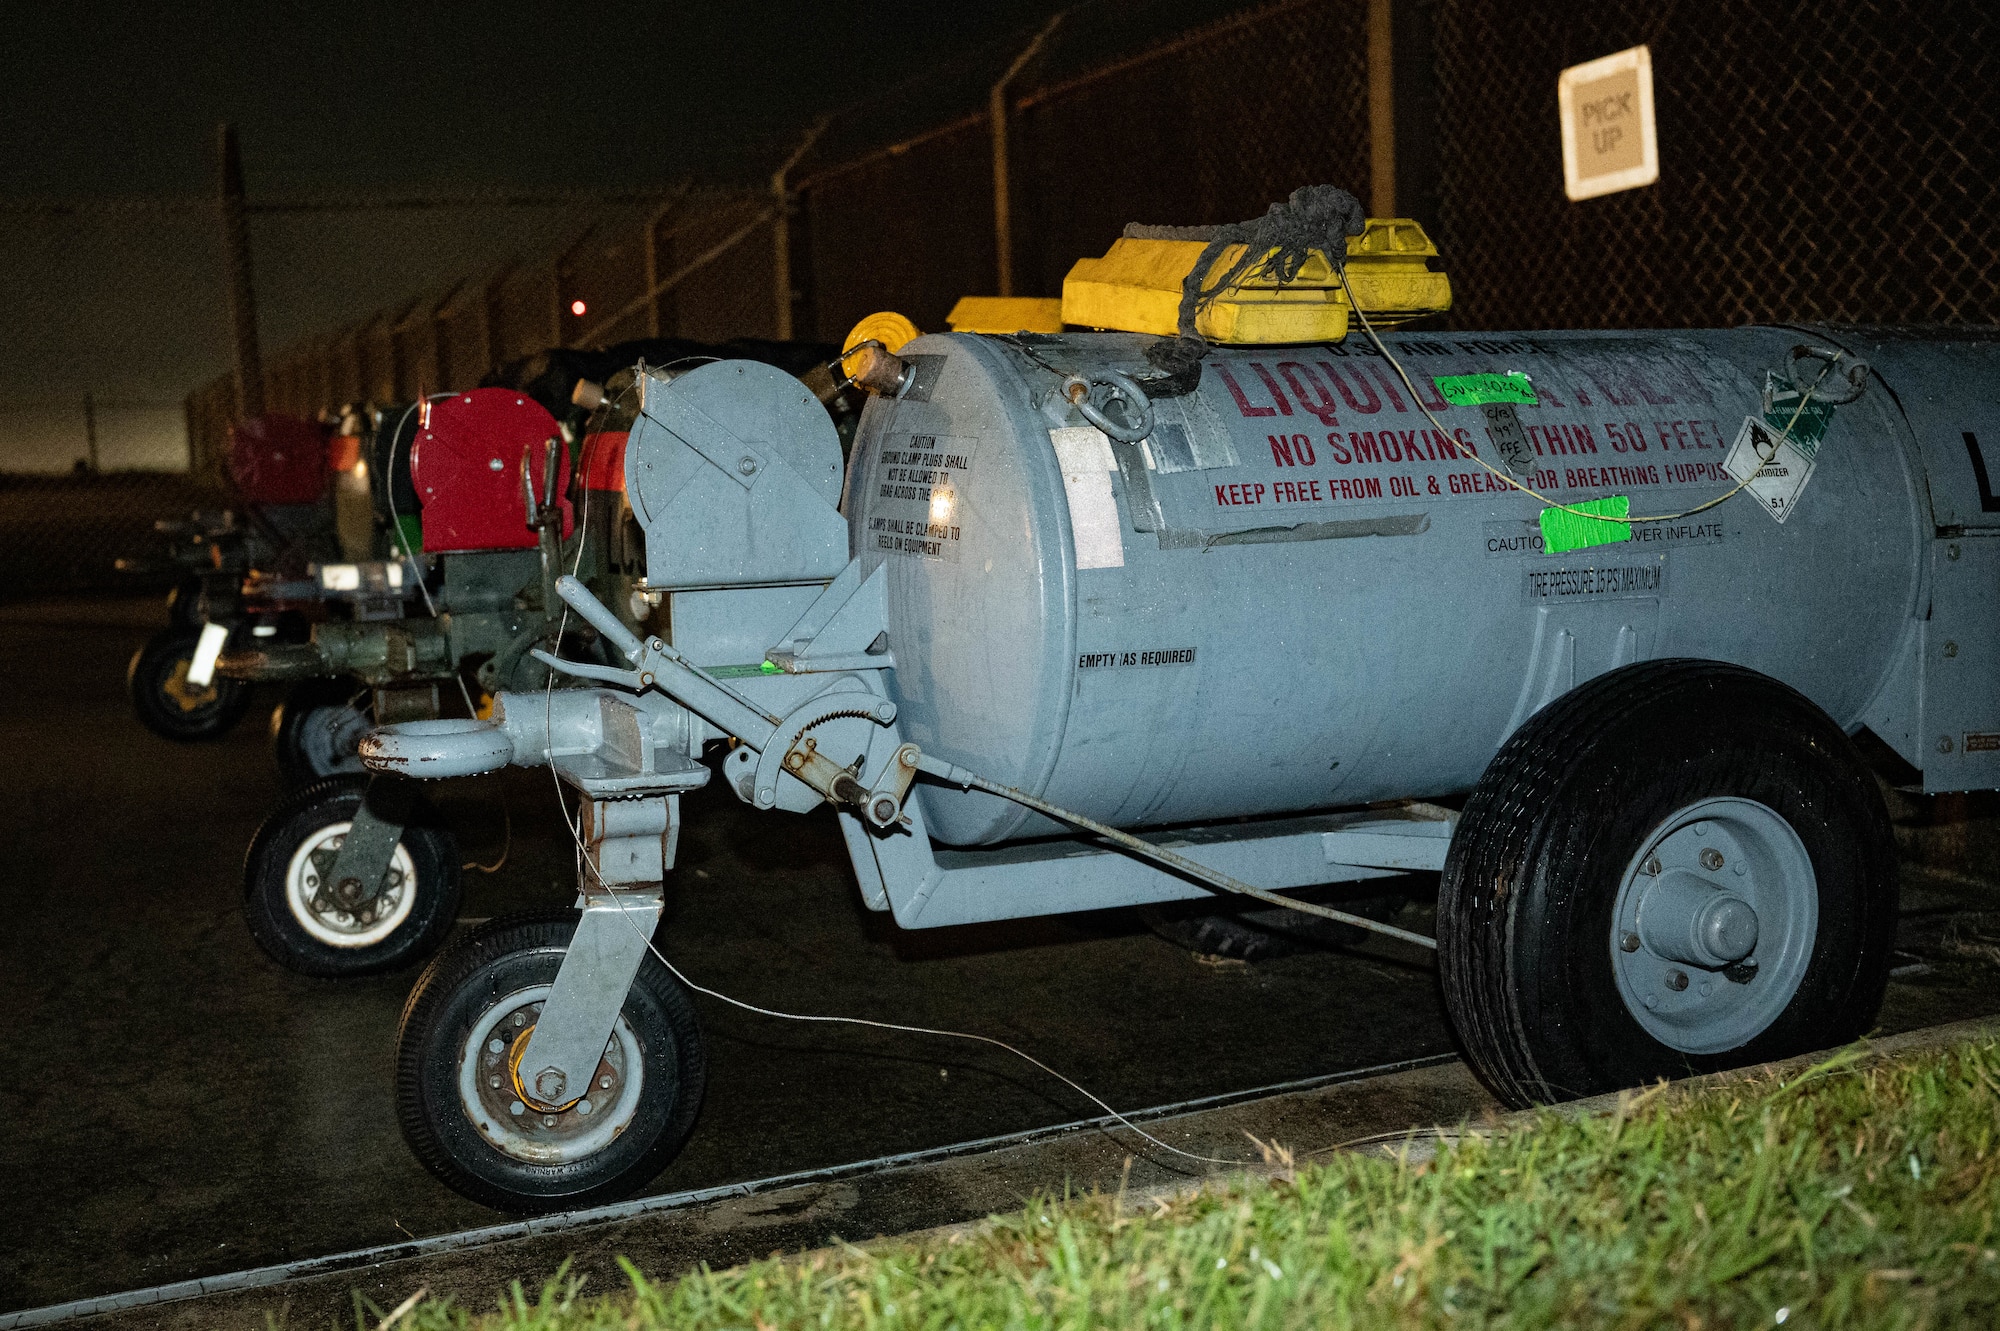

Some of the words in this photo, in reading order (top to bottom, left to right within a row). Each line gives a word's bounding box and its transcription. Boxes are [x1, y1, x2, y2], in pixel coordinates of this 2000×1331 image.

[1581, 92, 1631, 127] PICK
[1592, 126, 1622, 154] UP
[1396, 342, 1454, 356] AIR
[1209, 360, 1449, 427] LIQUID
[909, 435, 936, 449] CAUTION
[1267, 434, 1316, 467] NO
[1327, 428, 1478, 465] SMOKING
[1485, 423, 1598, 457] THIN
[1604, 421, 1648, 453] 50
[1653, 419, 1725, 451] FEET
[901, 451, 921, 466] CLAMP
[921, 453, 944, 467] PLUGS
[945, 455, 968, 470] SHALL
[888, 468, 898, 481] NOT
[900, 469, 908, 482] BE
[908, 470, 938, 484] ALLOWED
[940, 471, 949, 485] TO
[1215, 483, 1265, 506] KEEP
[1273, 480, 1322, 503] FREE
[1329, 477, 1382, 500] FROM
[1390, 476, 1420, 497] OIL
[1427, 475, 1441, 495] &
[1450, 471, 1520, 494] GREASE
[1527, 468, 1560, 490] FOR
[1567, 463, 1660, 488] BREATHING
[1666, 461, 1735, 483] PURPOS
[894, 485, 916, 500] ACROSS
[918, 488, 930, 501] THE
[1771, 497, 1785, 509] 5.1
[887, 519, 904, 534] SHALL
[905, 521, 915, 535] BE
[916, 522, 948, 539] CLAMPED
[951, 526, 960, 541] TO
[1487, 535, 1546, 552] CAUTIO
[1666, 524, 1722, 540] INFLATE
[878, 535, 893, 549] REELS
[894, 537, 903, 550] ON
[904, 538, 942, 555] EQUIPMENT
[1529, 572, 1548, 597] TIRE
[1550, 569, 1594, 595] PRESSURE
[1596, 568, 1606, 593] 15
[1607, 566, 1621, 591] PSI
[1621, 565, 1661, 591] MAXIMUM
[1079, 653, 1116, 668] EMPTY
